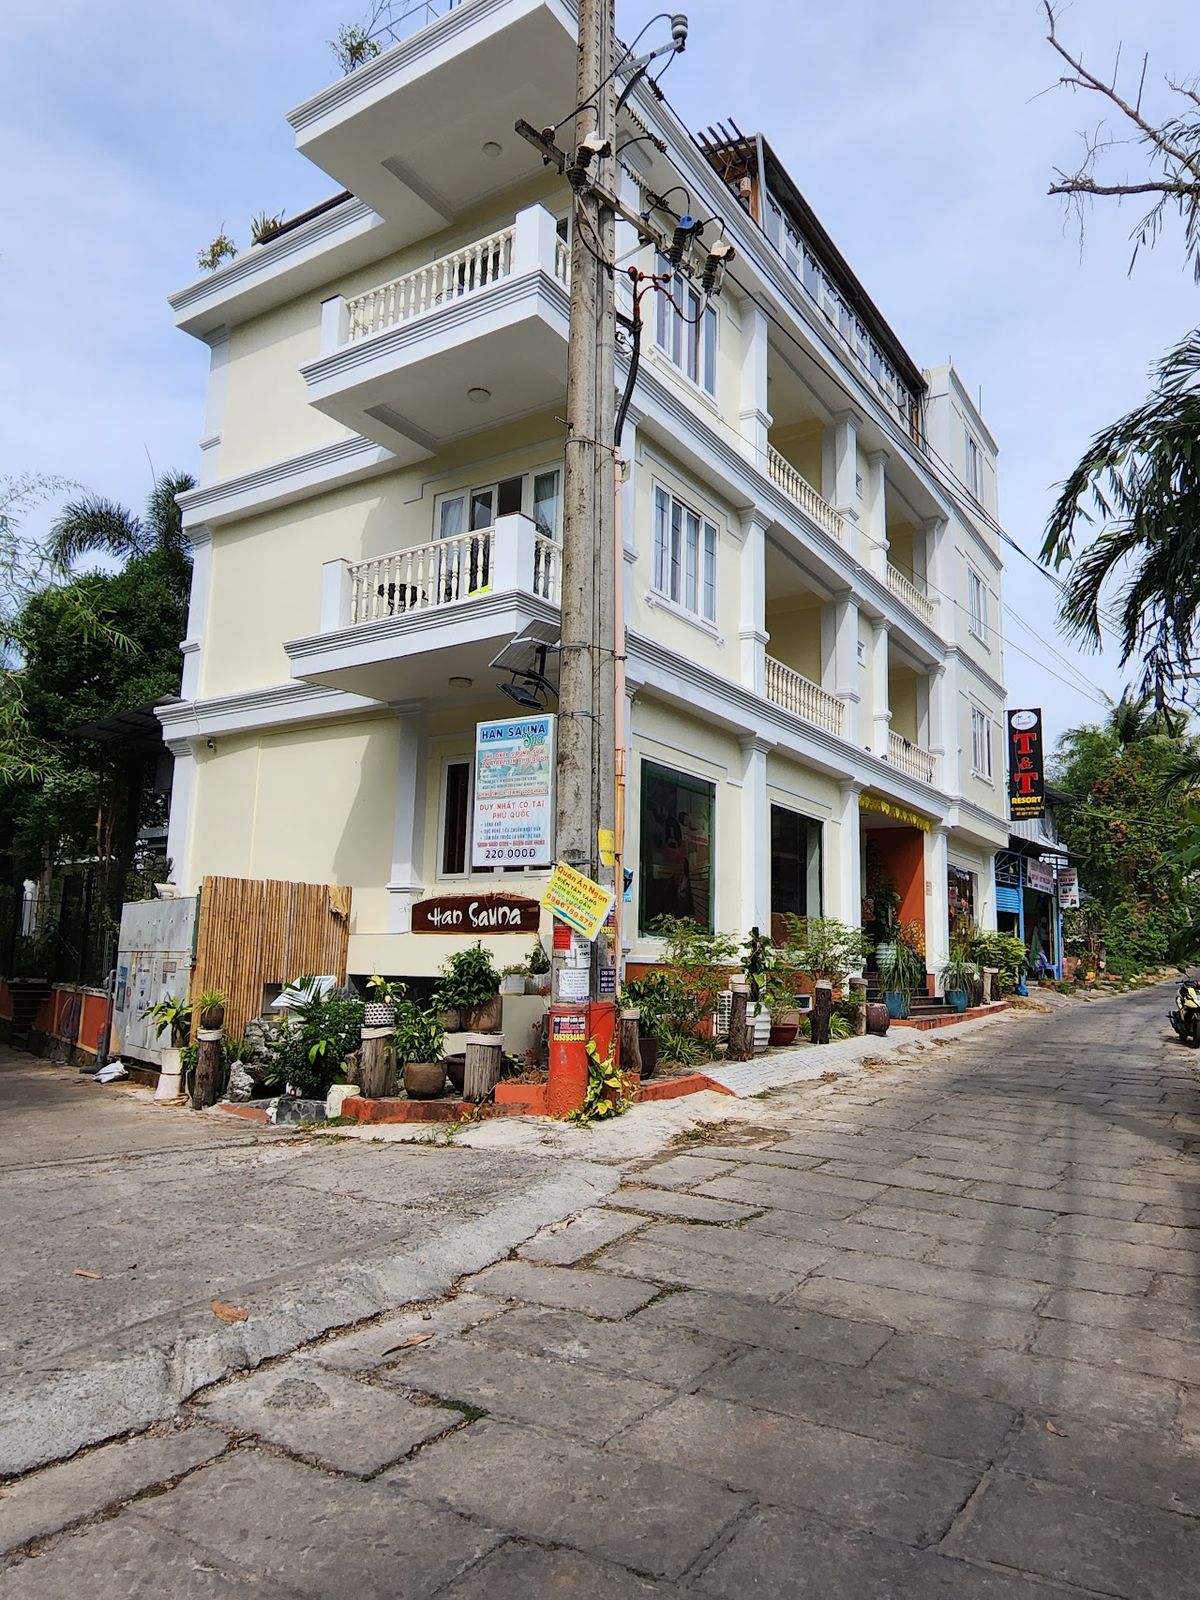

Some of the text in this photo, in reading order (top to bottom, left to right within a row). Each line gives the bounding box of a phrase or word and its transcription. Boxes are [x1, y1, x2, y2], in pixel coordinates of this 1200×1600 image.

[482, 724, 545, 740] HAN SAUNA
[523, 732, 545, 749] Spa
[1011, 796, 1042, 805] RESORT
[558, 866, 575, 881] Quán
[588, 886, 608, 903] Ngon
[427, 902, 522, 928] Han Sauna
